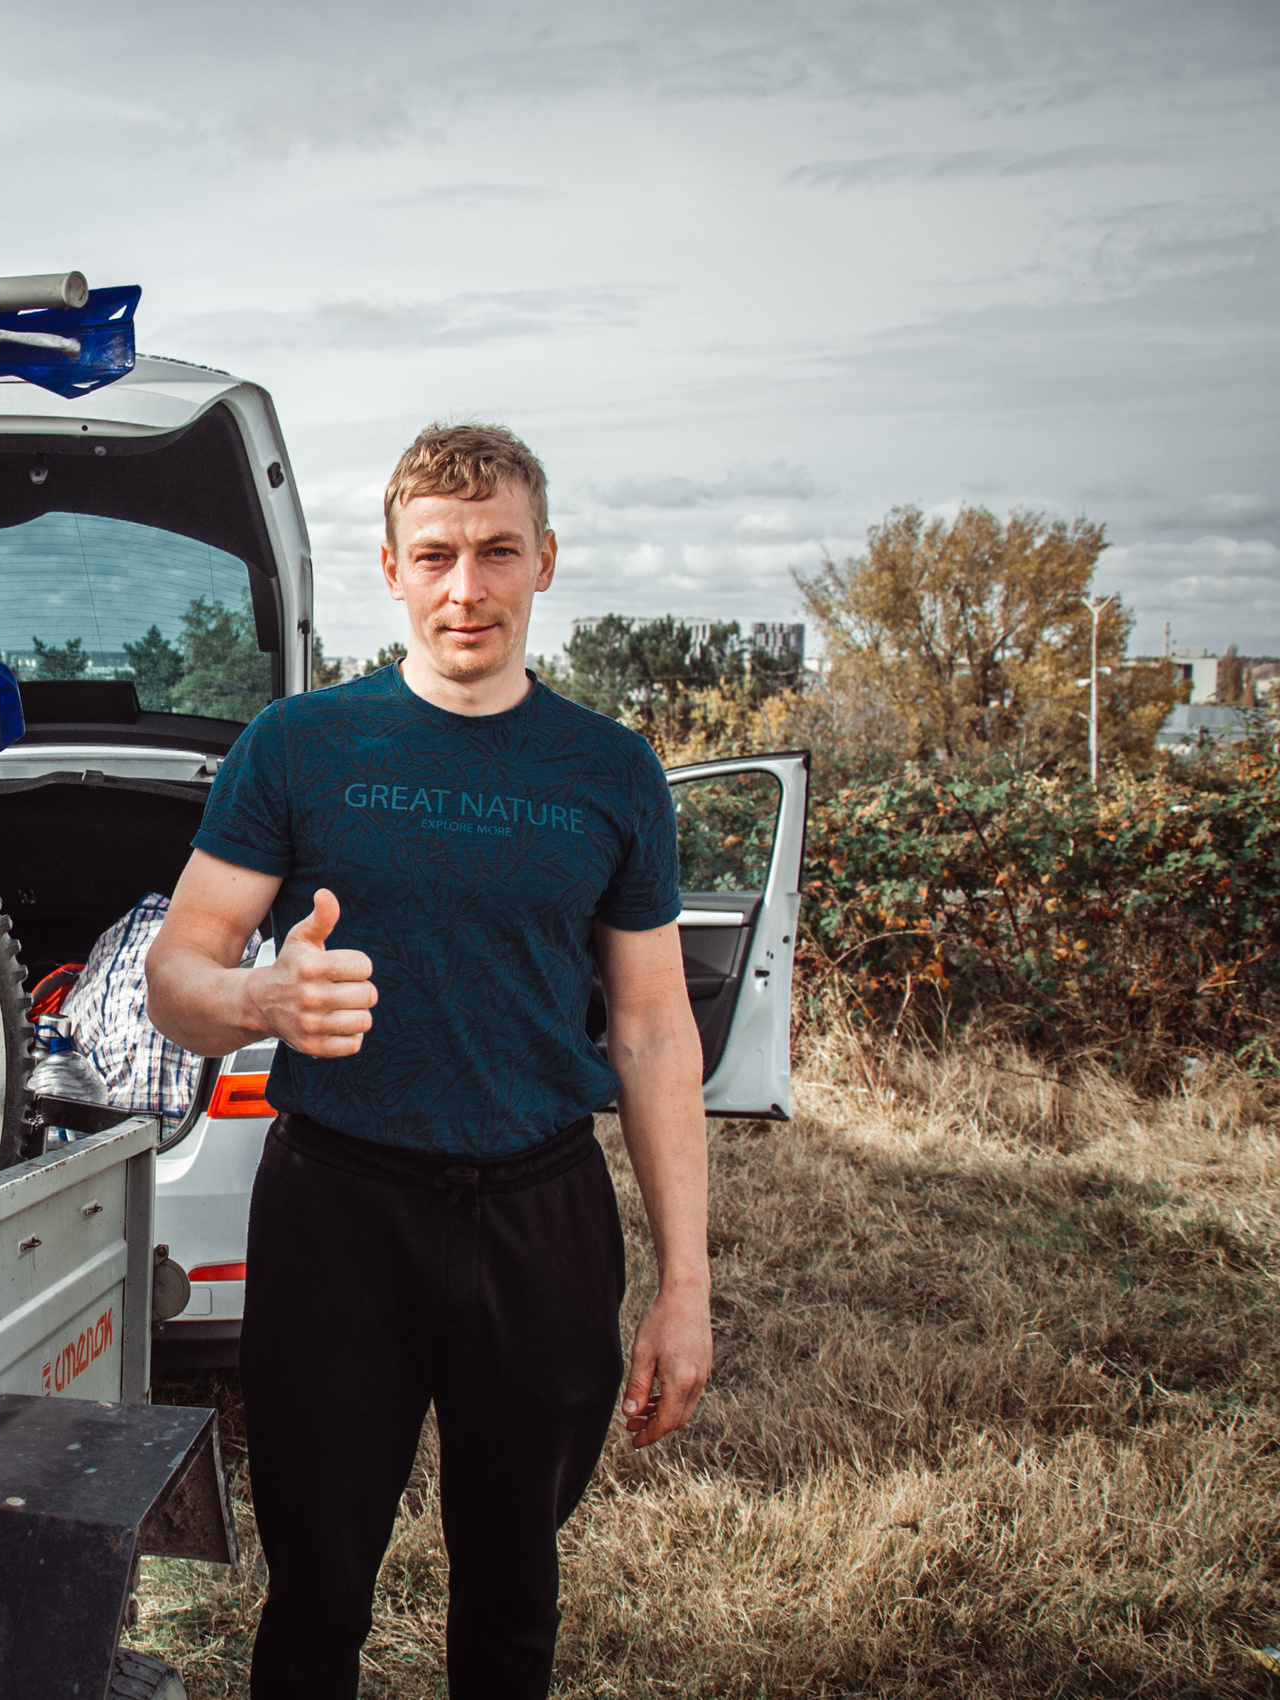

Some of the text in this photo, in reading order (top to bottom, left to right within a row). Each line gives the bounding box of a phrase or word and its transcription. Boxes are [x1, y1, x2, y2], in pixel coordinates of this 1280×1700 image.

[344, 783, 585, 835] GREAT NATURE
[420, 818, 512, 837] EXPLORE MORE
